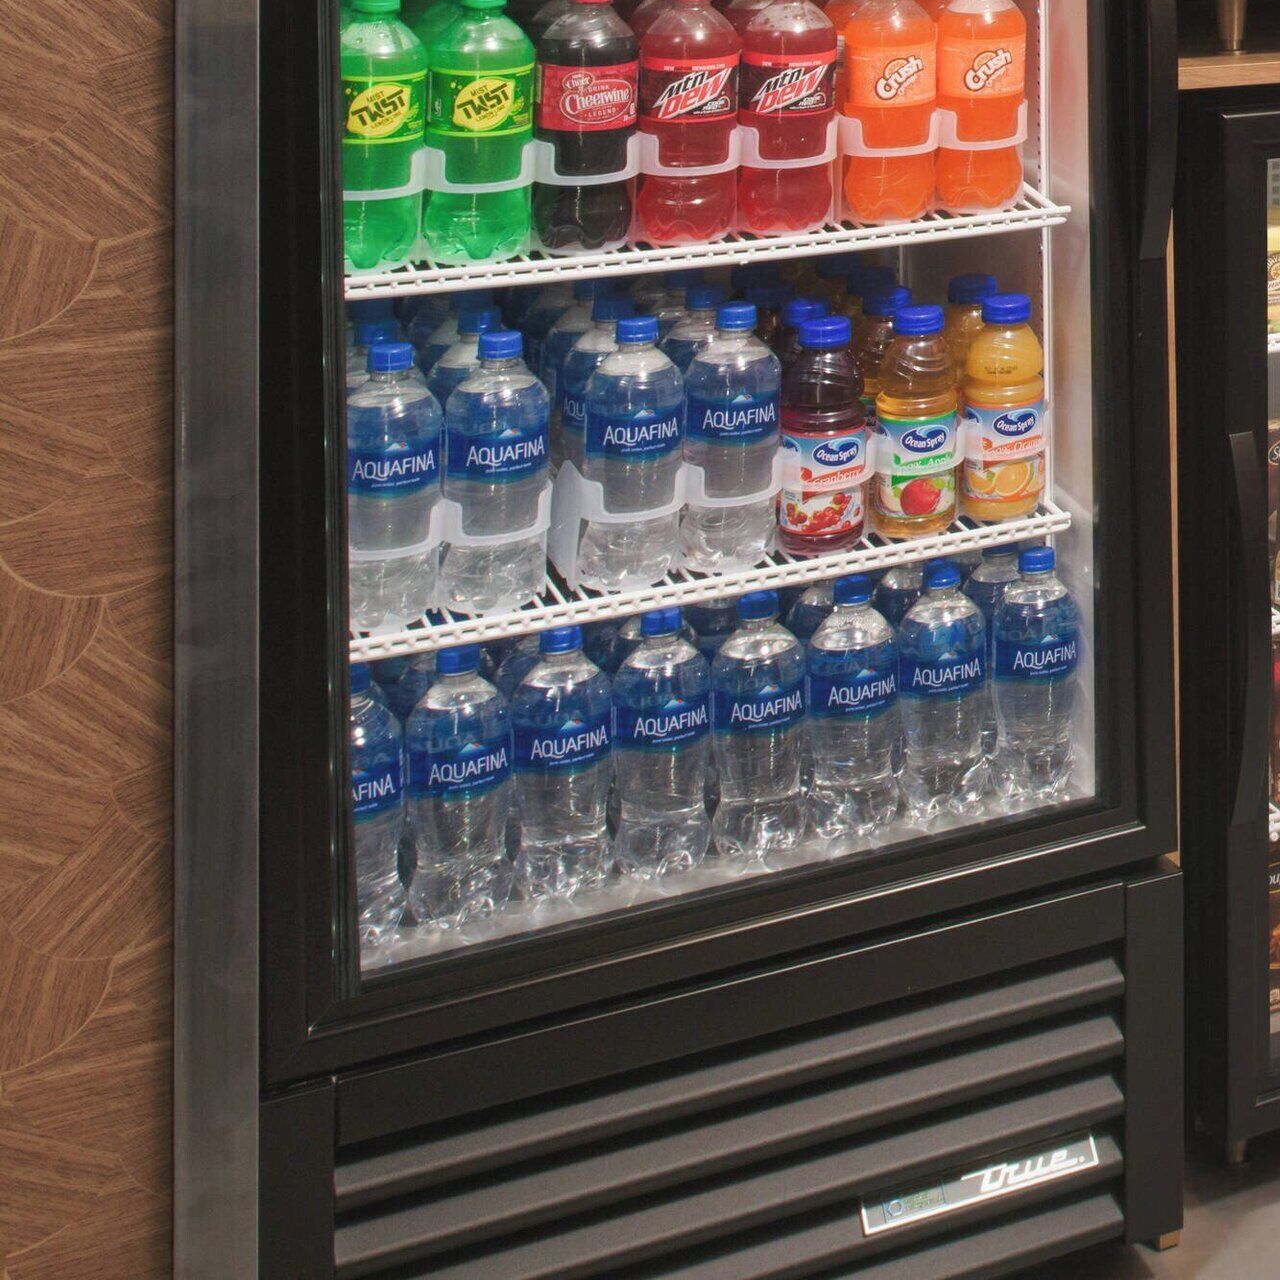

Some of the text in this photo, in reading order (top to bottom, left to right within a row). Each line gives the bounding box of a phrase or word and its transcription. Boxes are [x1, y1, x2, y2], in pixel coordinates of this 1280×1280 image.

[875, 56, 924, 100] Crush
[964, 49, 1012, 91] Crush
[565, 88, 630, 115] Cheerwine
[703, 403, 776, 431] AQUAFINA
[996, 416, 1036, 432] Ocean Spray
[603, 418, 678, 449] AQUAFINA
[905, 433, 945, 448] Ocean Spray
[352, 450, 434, 481] AQUAFINA
[467, 435, 545, 467] AQUAFINA
[816, 445, 858, 461] Ocean Spray
[1013, 640, 1076, 670] AQUAFINA
[913, 658, 980, 687] AQUAFINA
[828, 674, 896, 706] AQUAFINA
[634, 705, 707, 738] AQUAFINA
[731, 690, 802, 722] AQUAFINA
[531, 725, 608, 760] AQUAFINA
[429, 748, 508, 785] AQUAFINA
